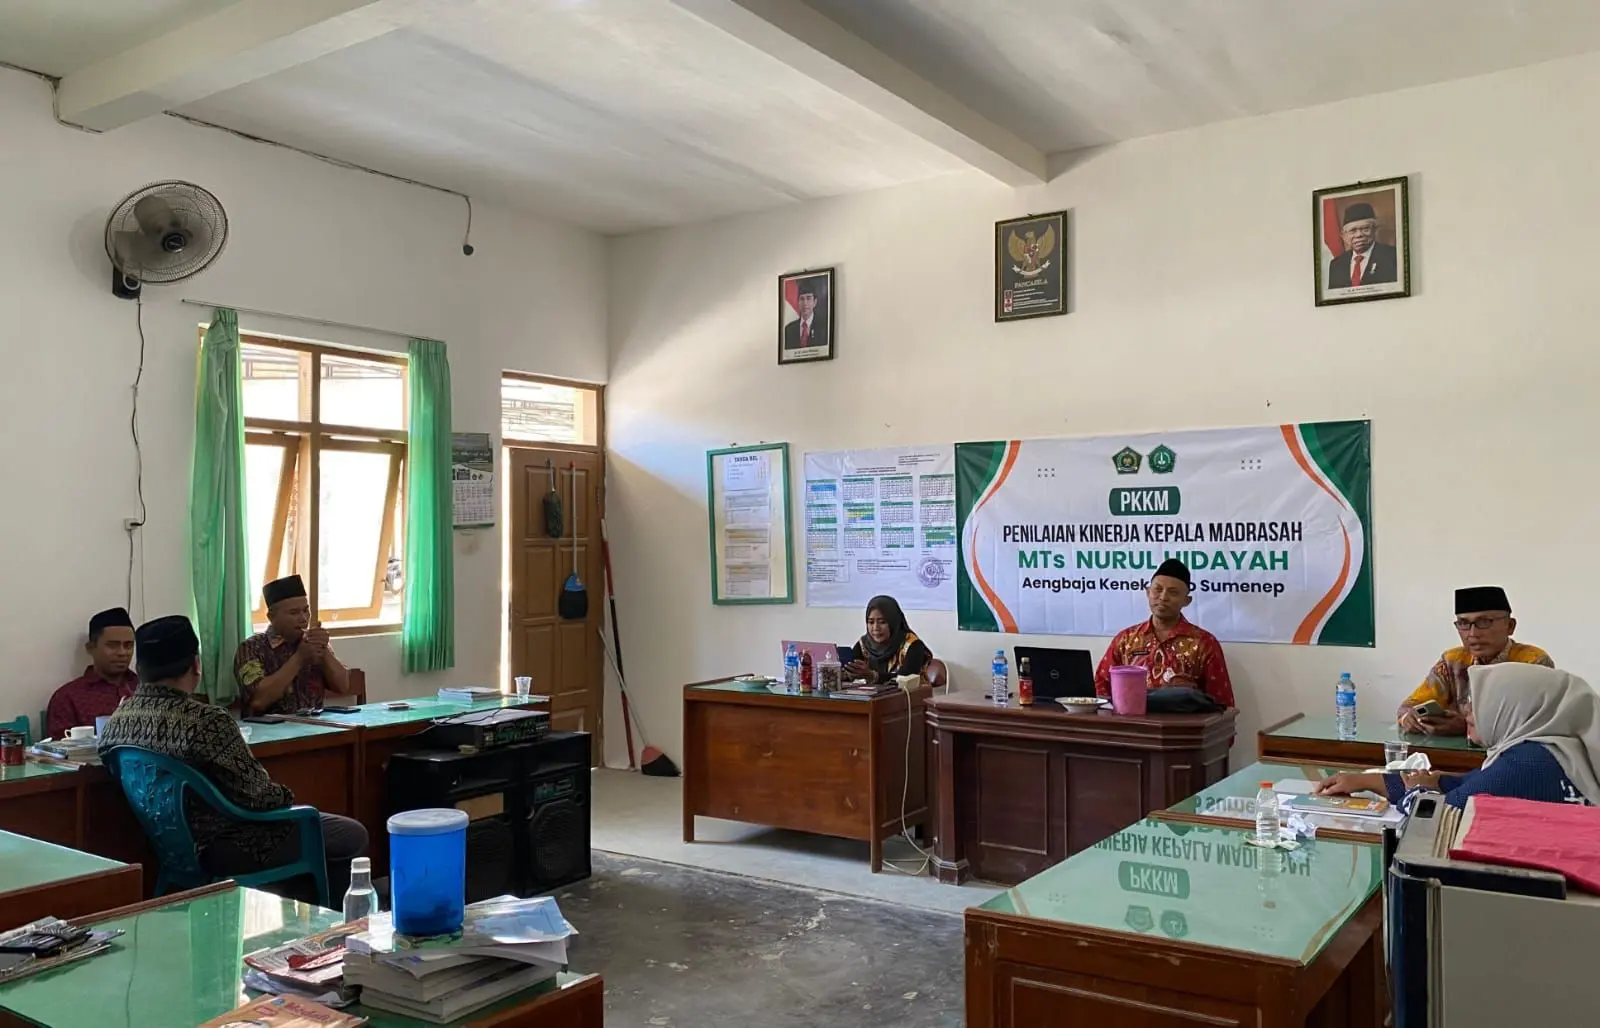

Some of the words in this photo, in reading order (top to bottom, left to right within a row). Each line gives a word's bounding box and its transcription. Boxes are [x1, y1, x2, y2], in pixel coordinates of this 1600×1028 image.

[1120, 490, 1169, 512] PKKM
[1003, 524, 1075, 543] PENILAIAN
[1079, 523, 1140, 543] KINERJA
[1144, 522, 1204, 543] KEPALA
[1209, 521, 1303, 542] MADRASAH
[1018, 550, 1065, 569] MTs
[1076, 550, 1158, 569] NURUL
[1022, 577, 1096, 594] Aengbaja
[1099, 578, 1150, 591] Kenek
[1200, 579, 1285, 597] Sumenep
